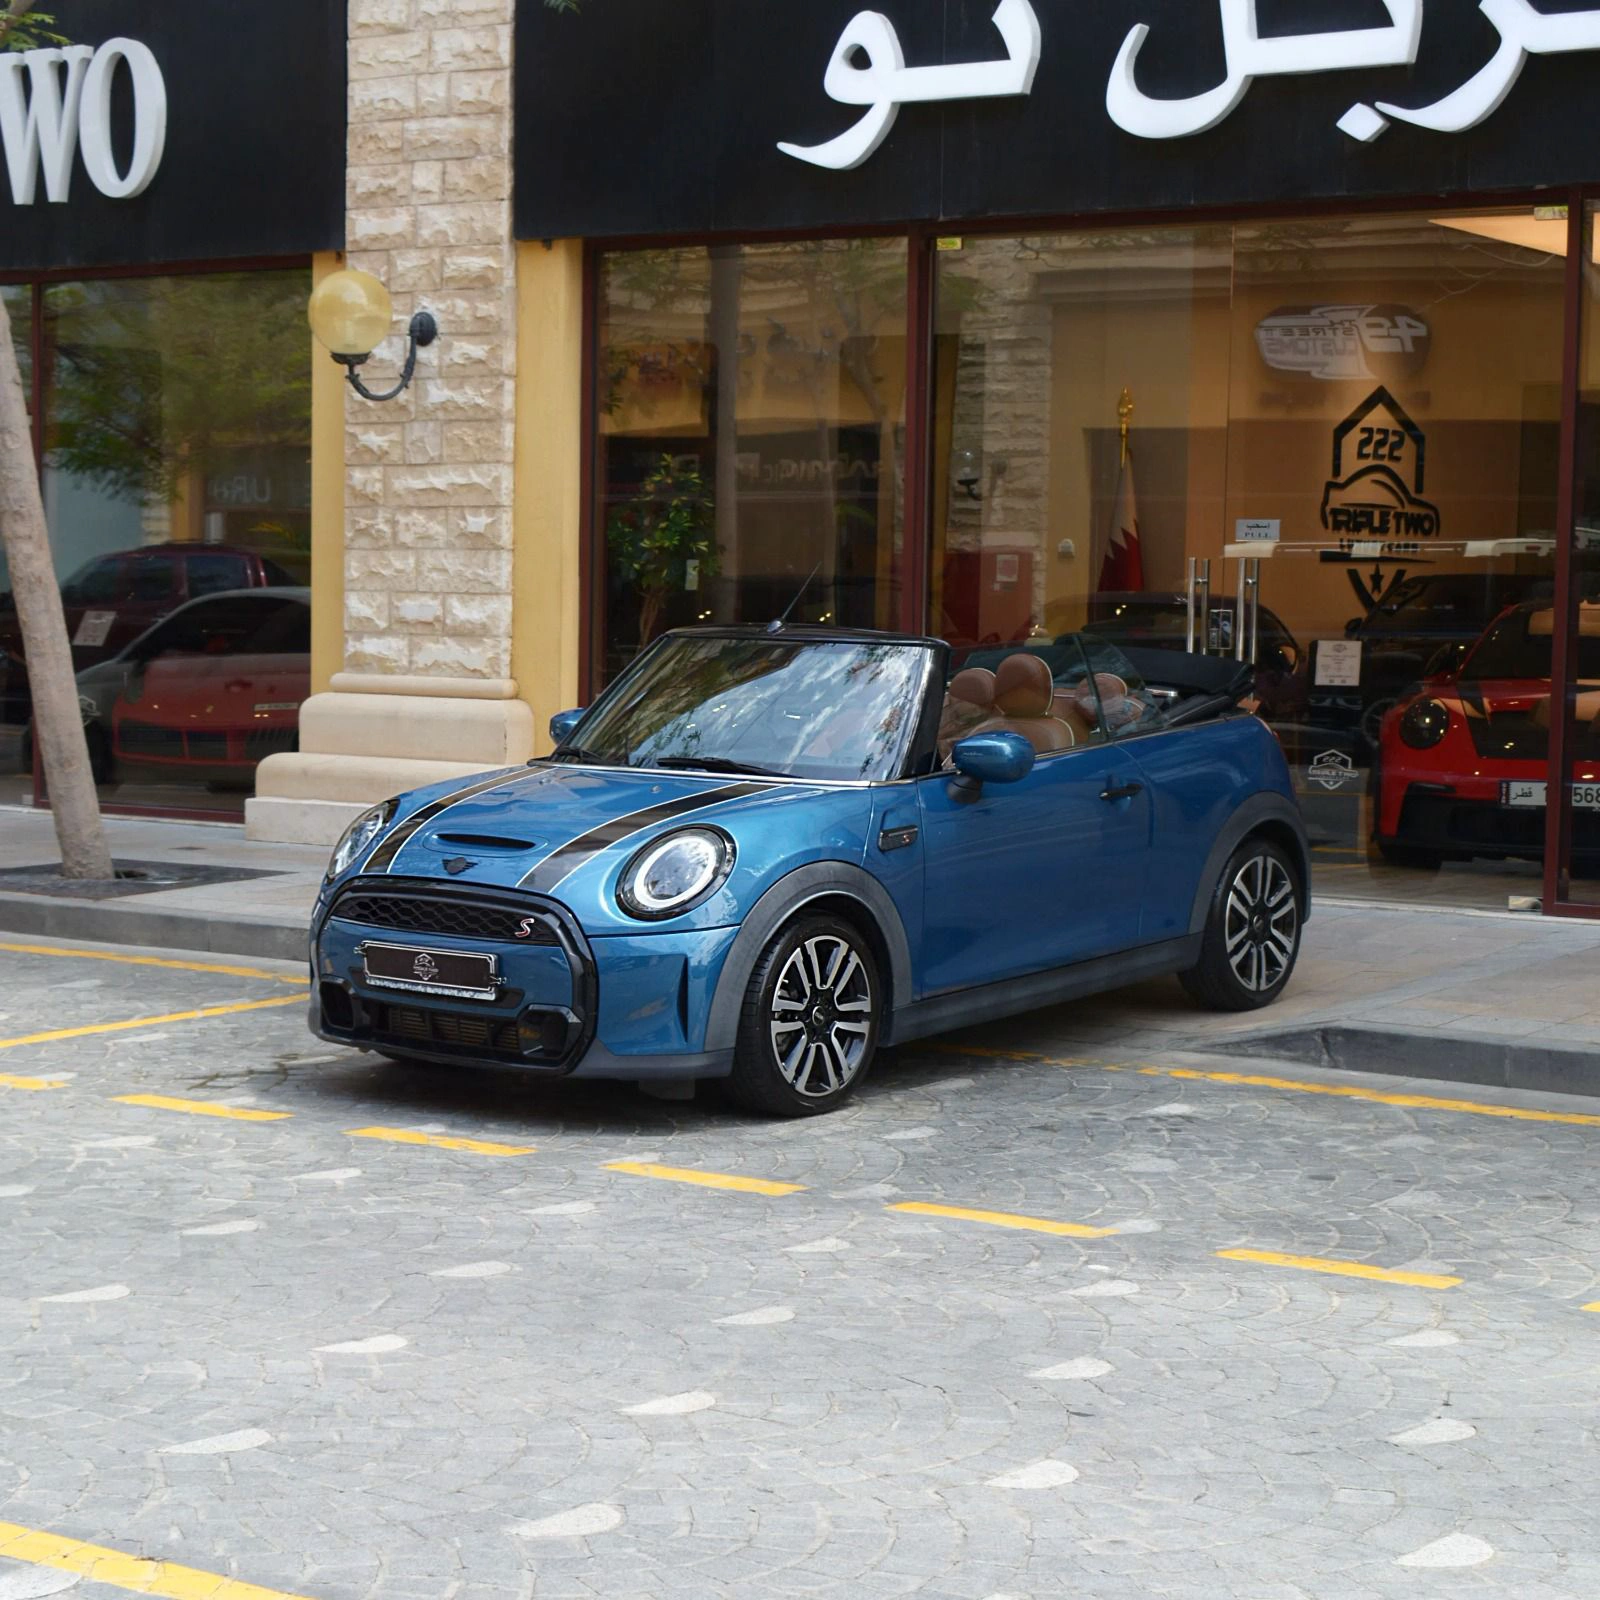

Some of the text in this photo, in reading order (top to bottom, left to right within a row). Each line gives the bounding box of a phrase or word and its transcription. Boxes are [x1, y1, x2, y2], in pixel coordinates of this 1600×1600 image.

[1356, 427, 1406, 461] 222
[1329, 507, 1435, 536] TRIPLE TWO
[514, 917, 535, 938] S
